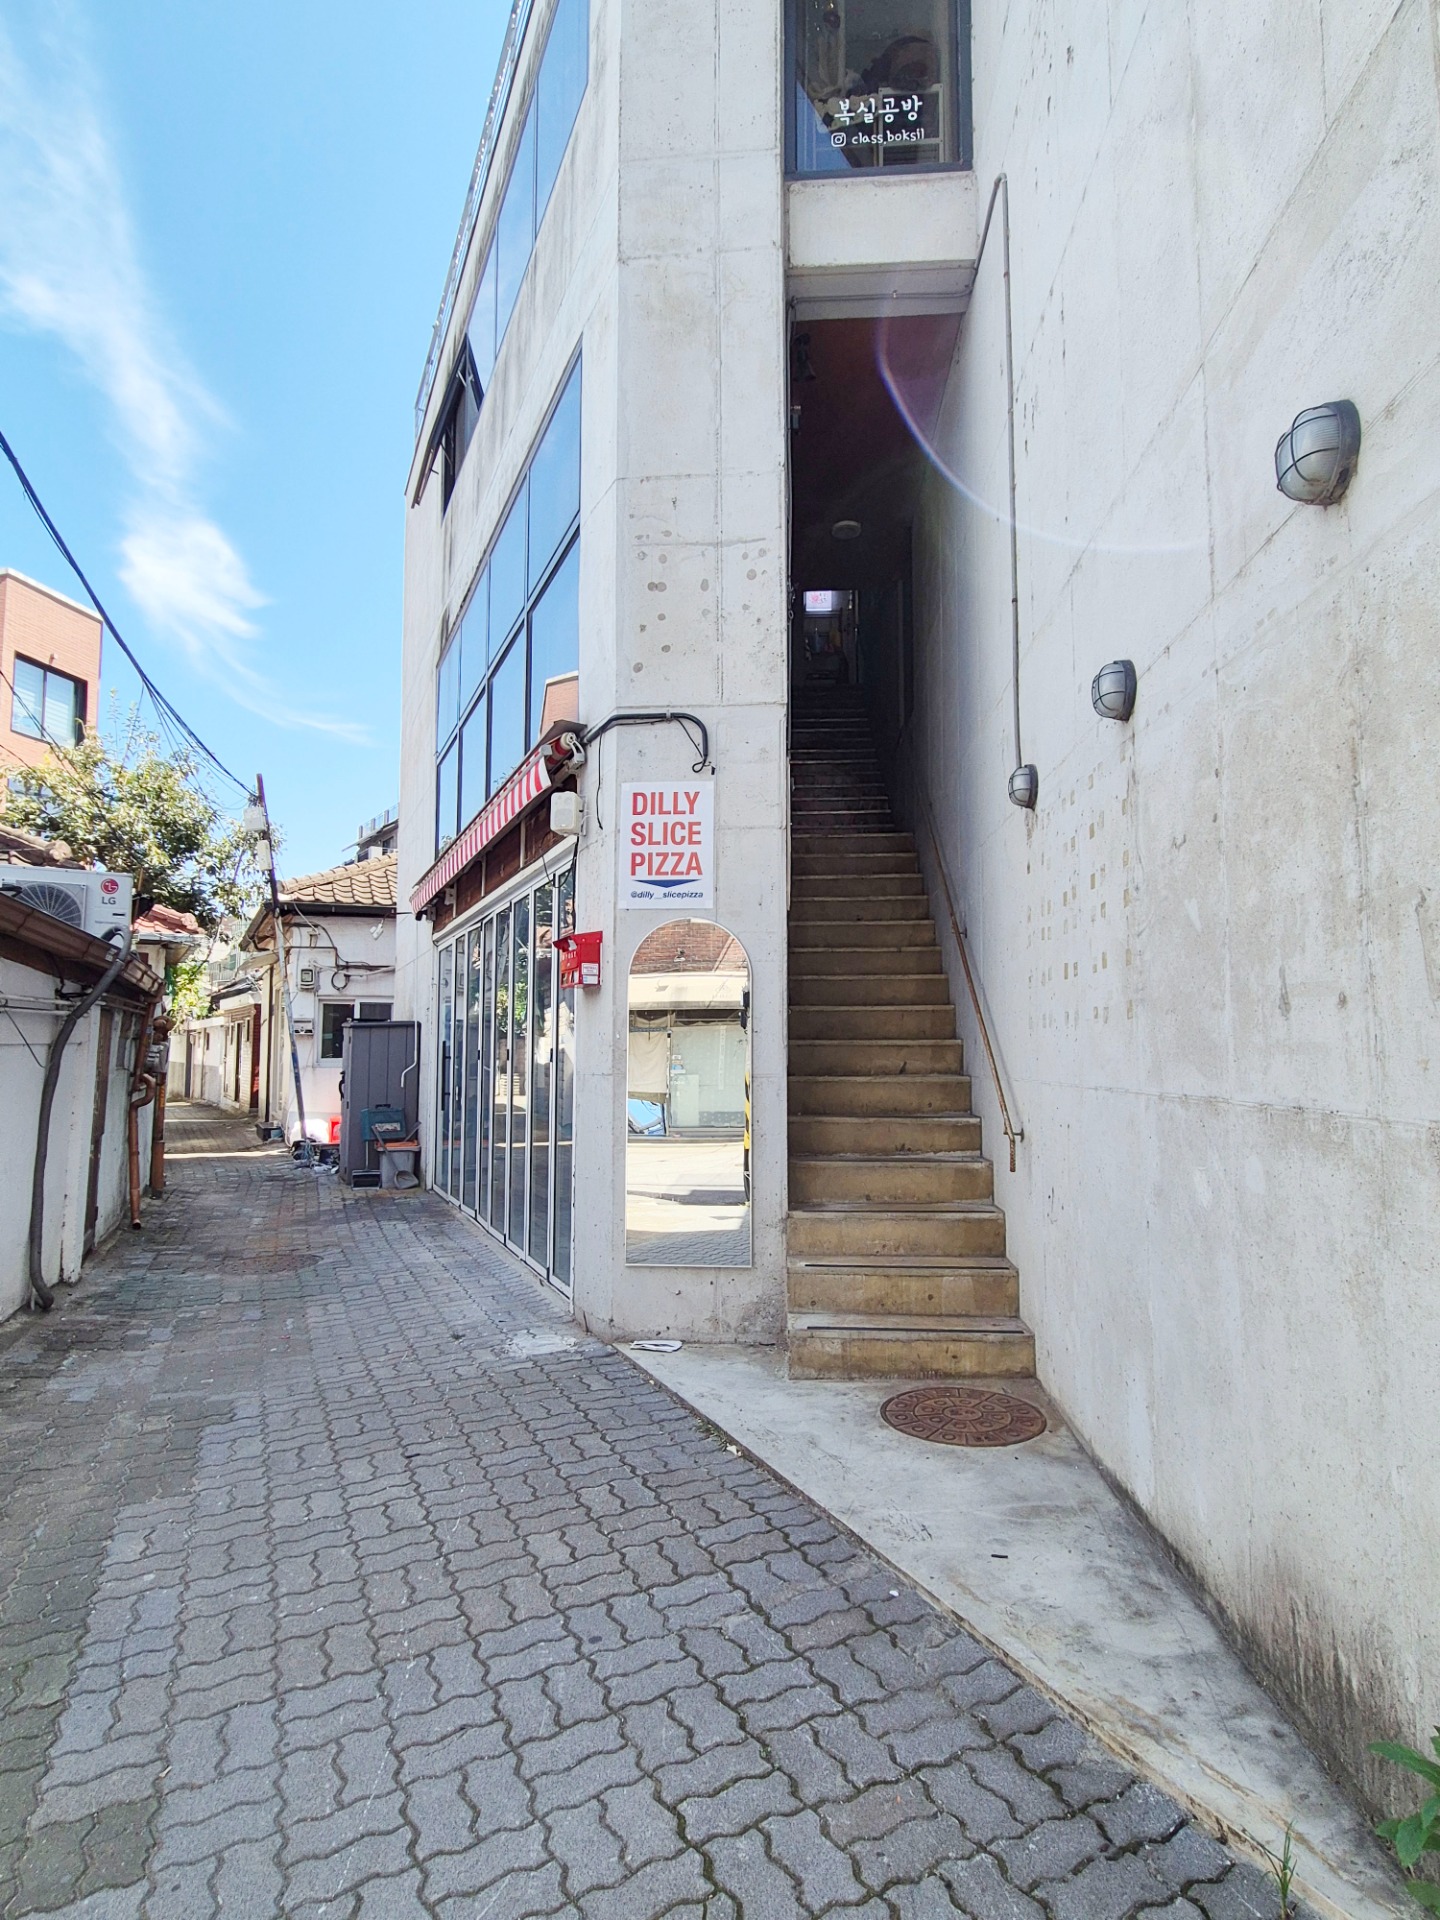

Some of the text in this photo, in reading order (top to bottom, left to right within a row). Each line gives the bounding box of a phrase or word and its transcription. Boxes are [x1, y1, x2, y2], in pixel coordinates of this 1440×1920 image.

[834, 95, 923, 125] 복실공방
[851, 128, 925, 145] class.boksil
[632, 791, 701, 816] DILLY
[630, 821, 702, 846] SLICE
[630, 851, 703, 876] PIZZA
[102, 897, 116, 905] LG
